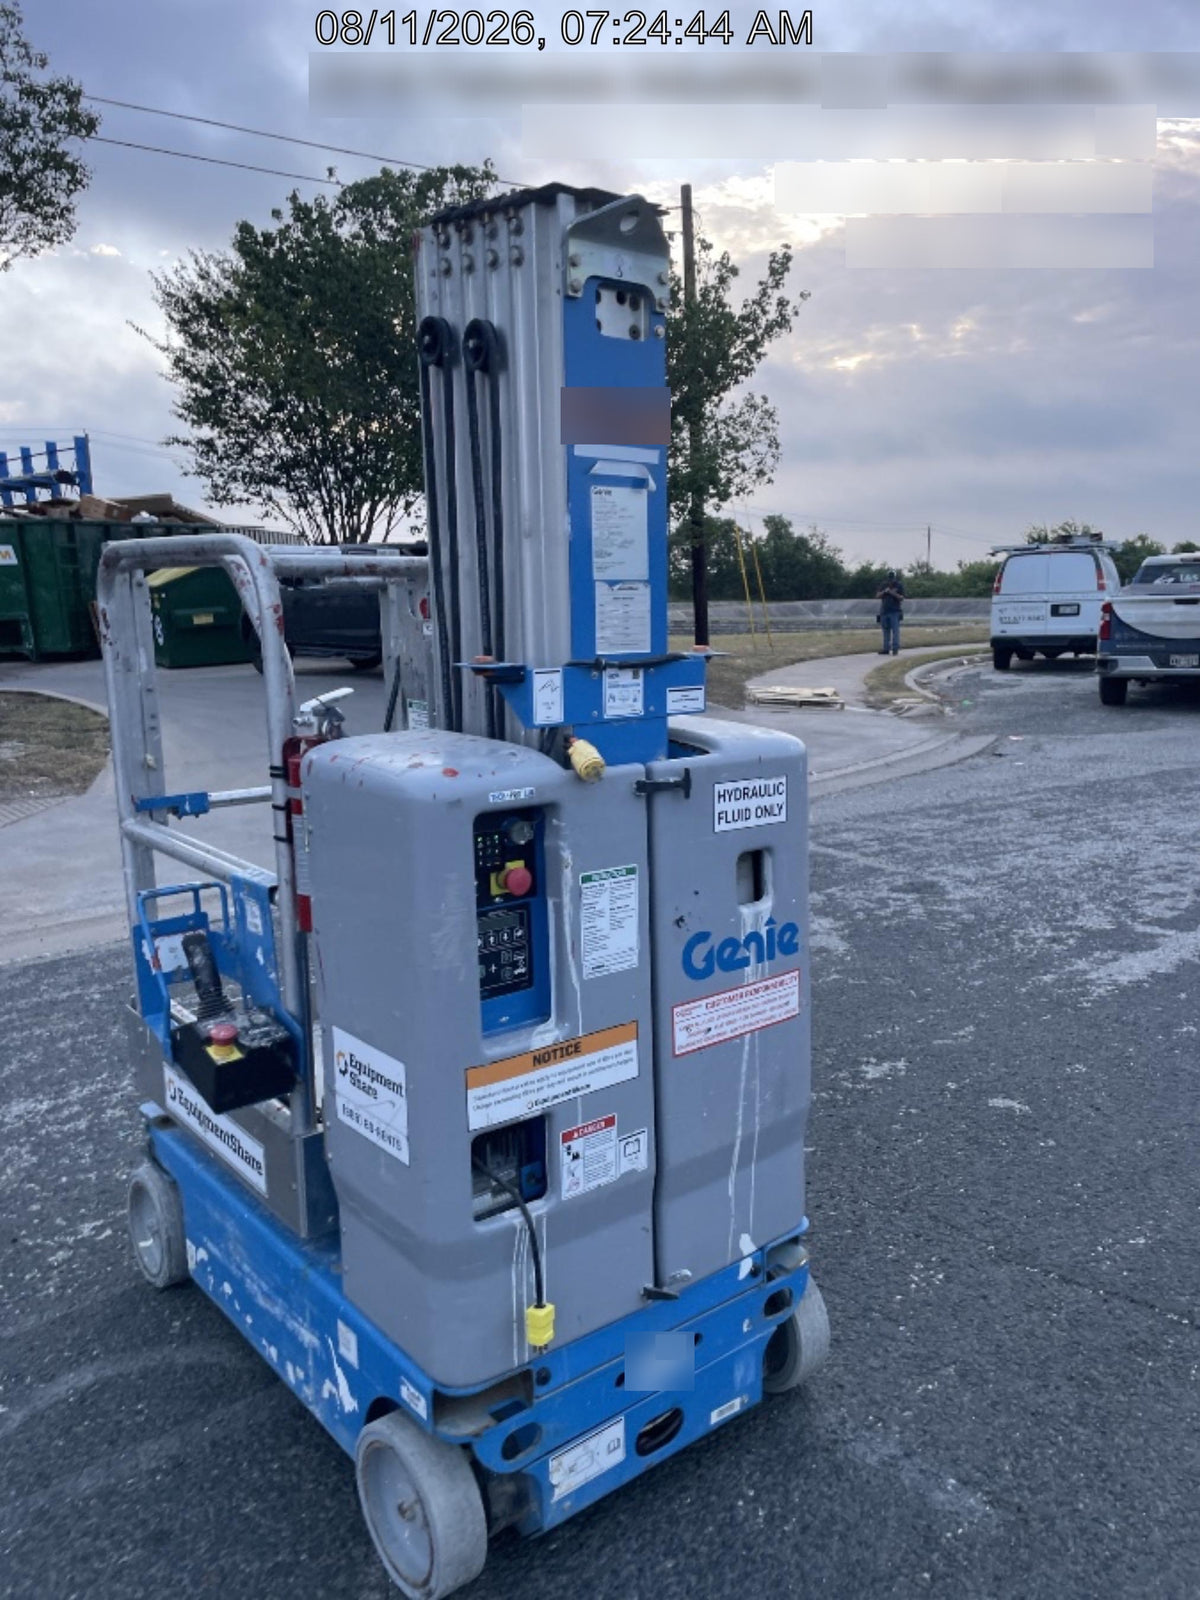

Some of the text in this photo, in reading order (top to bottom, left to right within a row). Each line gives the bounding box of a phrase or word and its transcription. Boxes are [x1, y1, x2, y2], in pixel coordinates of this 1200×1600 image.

[717, 782, 785, 804] HYDRAULIC
[717, 802, 784, 825] FLUID ONLY
[682, 916, 800, 981] Genie
[533, 1041, 582, 1067] NOTICE
[349, 1052, 404, 1097] Equipment
